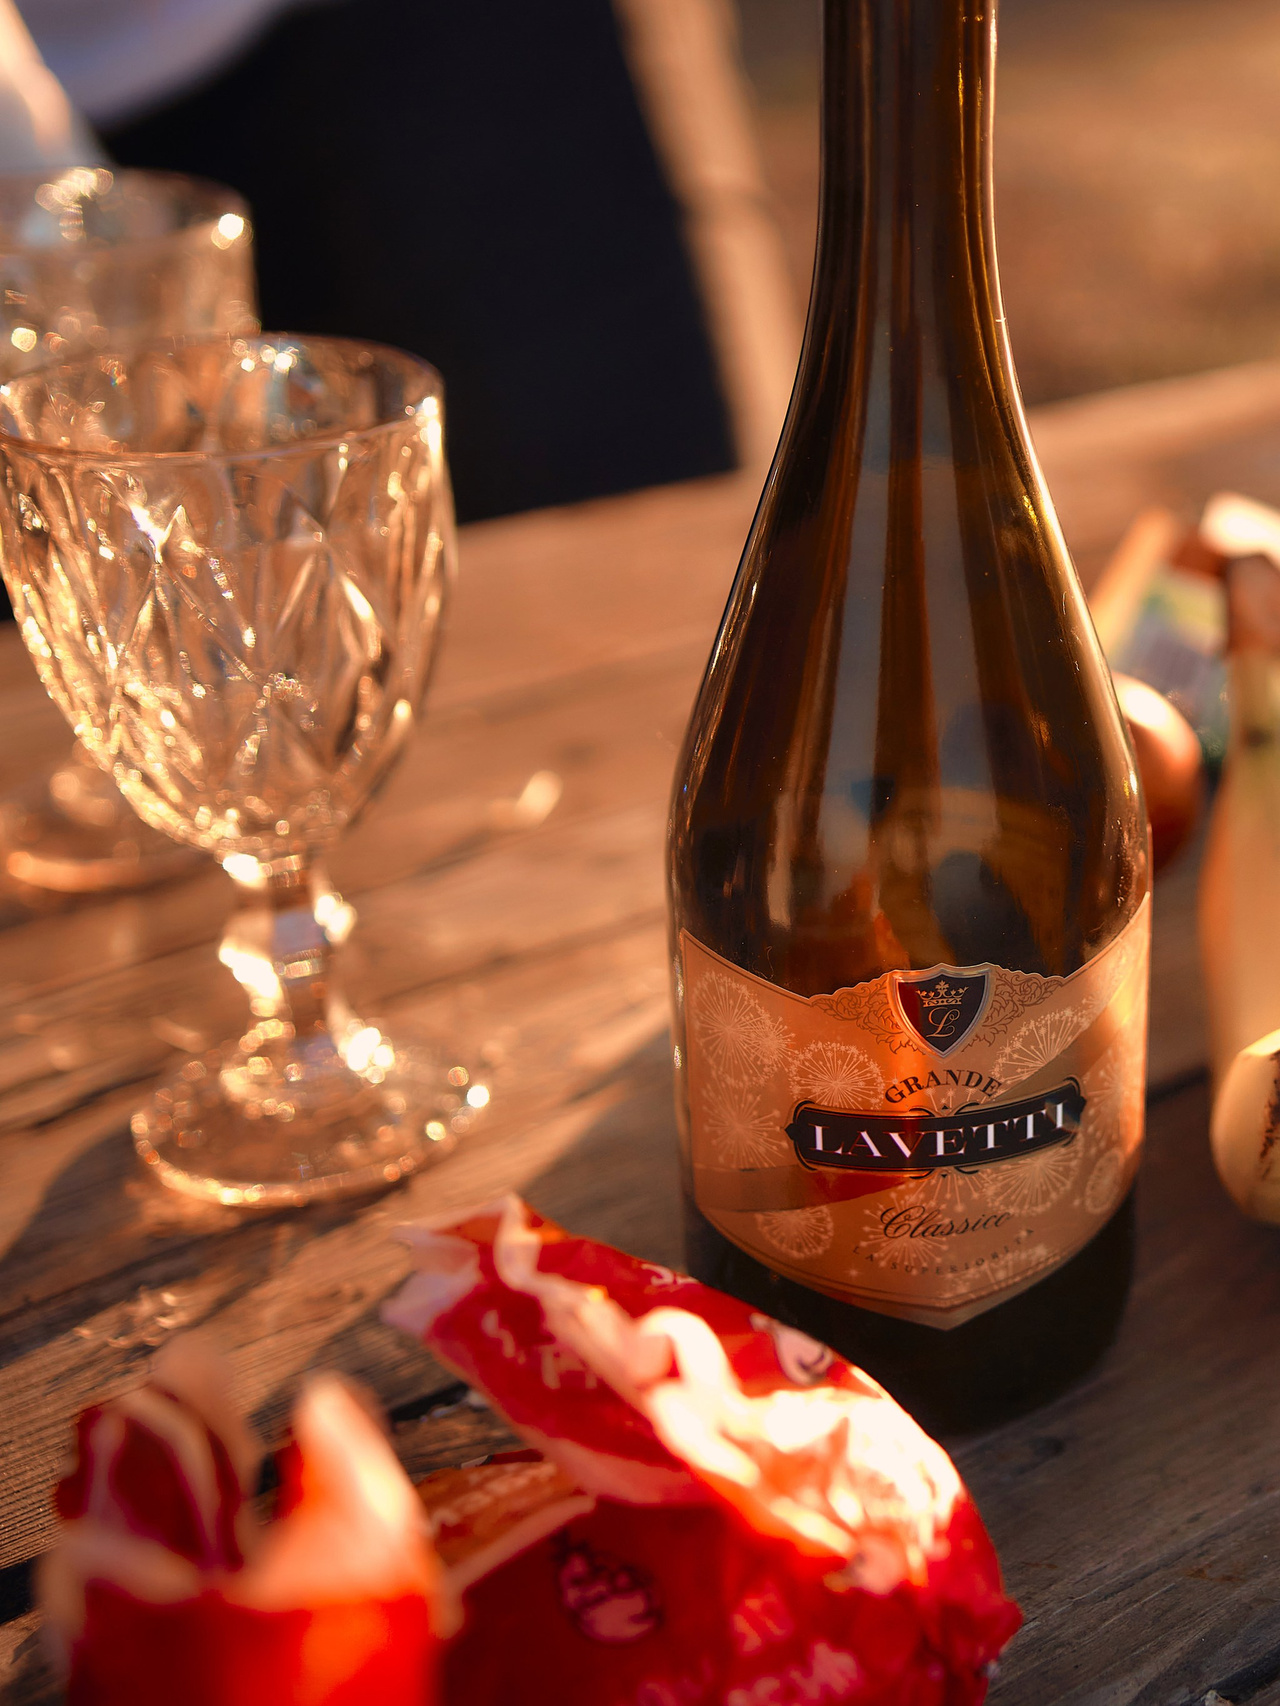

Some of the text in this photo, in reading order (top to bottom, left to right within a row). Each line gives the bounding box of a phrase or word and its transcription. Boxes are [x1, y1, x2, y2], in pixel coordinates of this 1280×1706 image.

[884, 1069, 1002, 1104] GRANDE
[807, 1101, 1075, 1158] LAVETTI
[880, 1205, 1011, 1239] Classico
